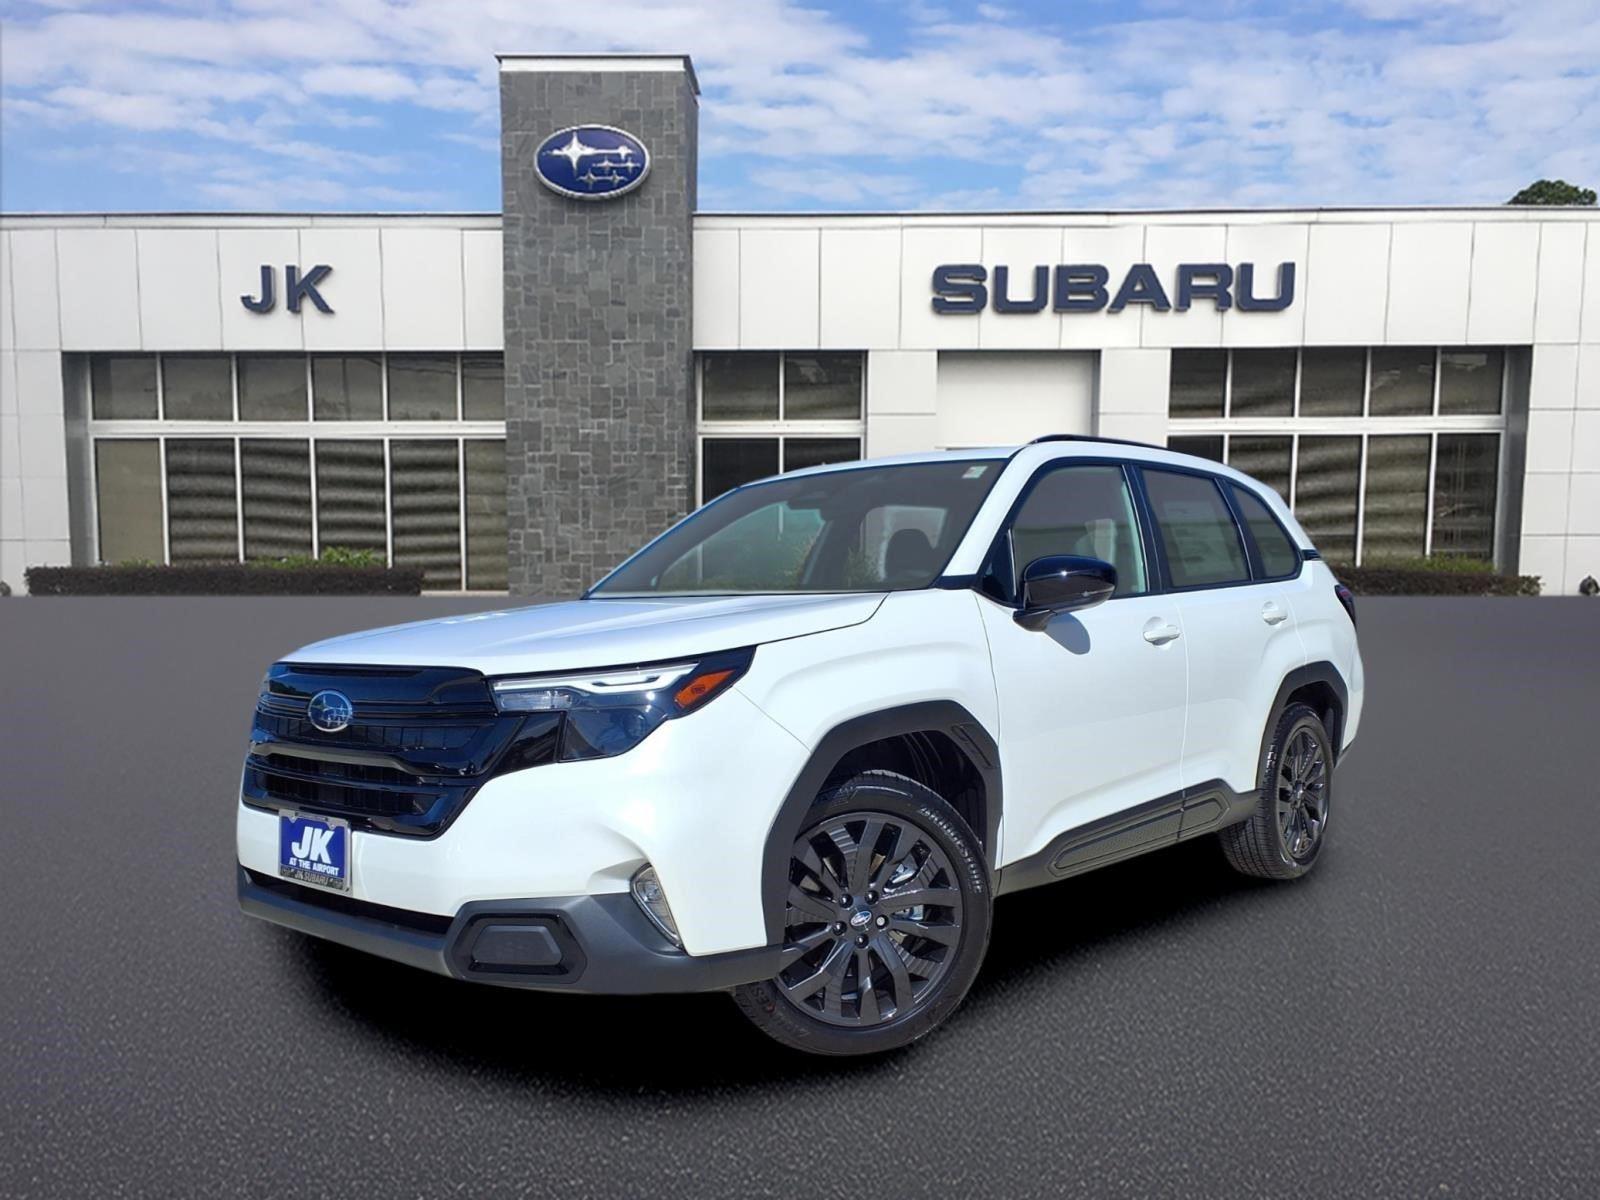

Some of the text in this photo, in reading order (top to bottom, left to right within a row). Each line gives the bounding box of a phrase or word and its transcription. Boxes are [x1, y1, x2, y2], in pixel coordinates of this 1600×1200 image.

[240, 264, 335, 315] JK
[931, 261, 1296, 315] SUBARU
[292, 826, 334, 864] JK
[289, 857, 339, 875] AT THE AIRPORT
[295, 870, 328, 885] JK SUBARU
